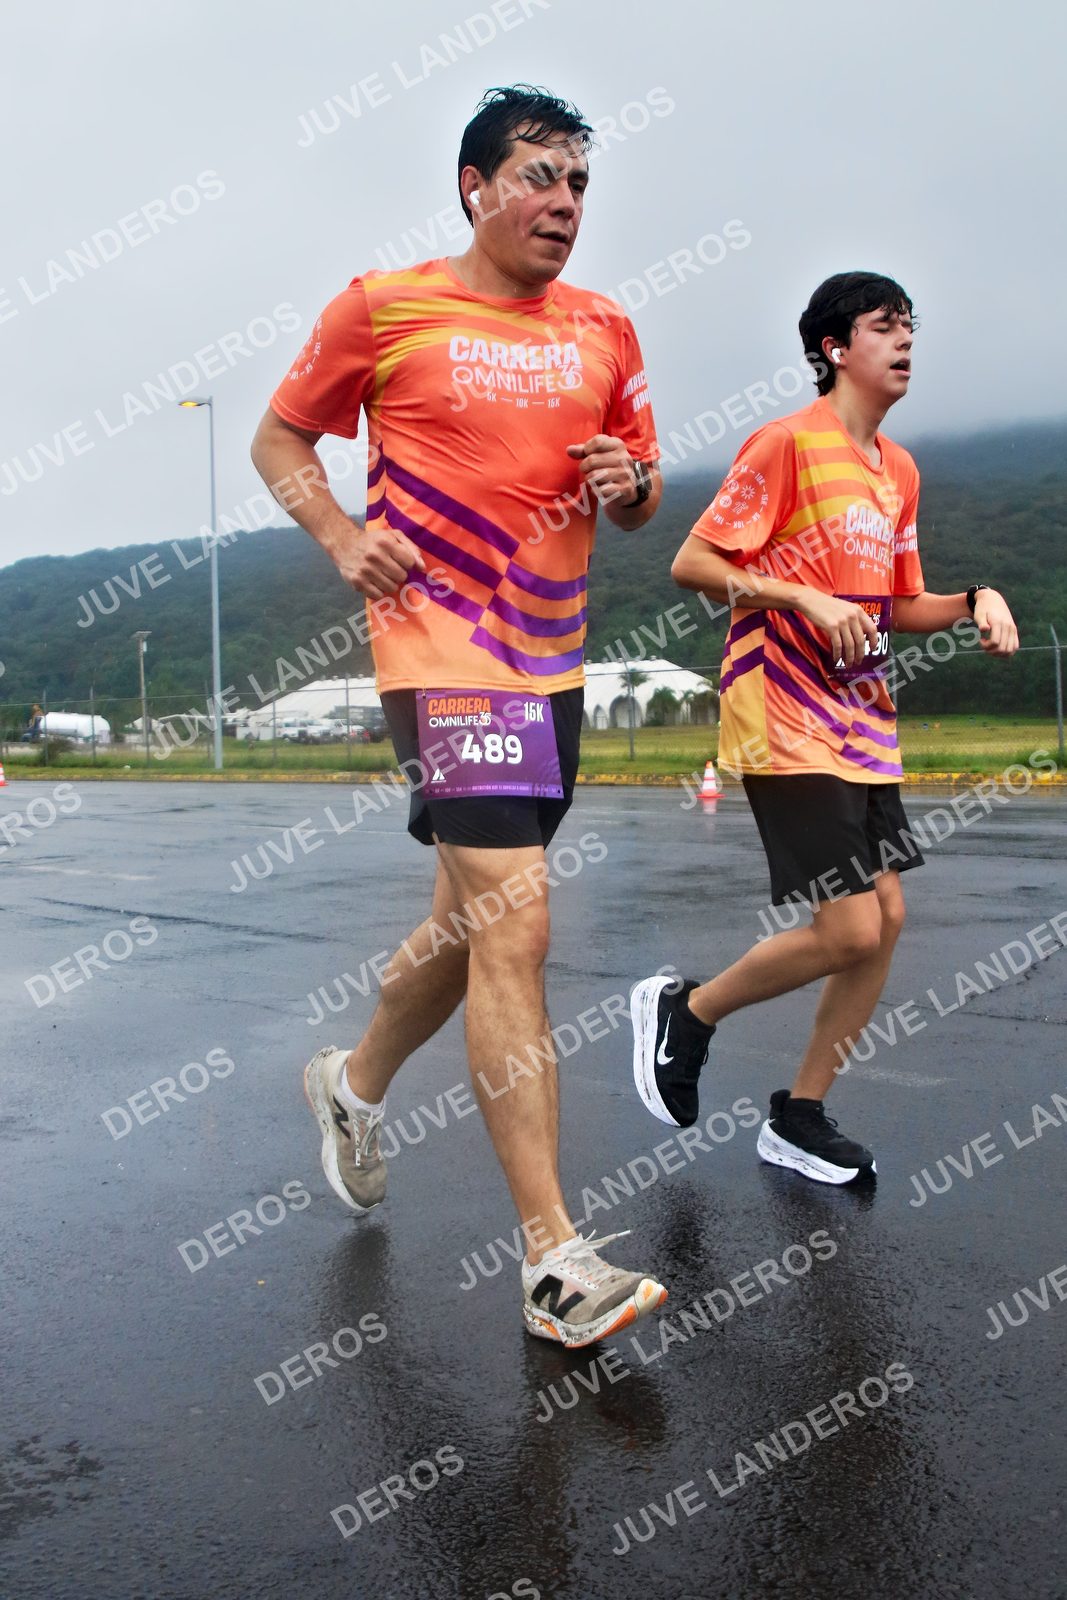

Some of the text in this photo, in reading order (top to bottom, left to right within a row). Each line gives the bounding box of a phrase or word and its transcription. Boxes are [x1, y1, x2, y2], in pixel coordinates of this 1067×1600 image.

[449, 336, 582, 371] CARRERA
[452, 366, 556, 393] OMNILIFE
[516, 397, 529, 409] 10K
[428, 697, 491, 715] CARRERA
[524, 701, 544, 723] 15K
[429, 715, 479, 728] OMNILIFE
[461, 733, 523, 765] 489
